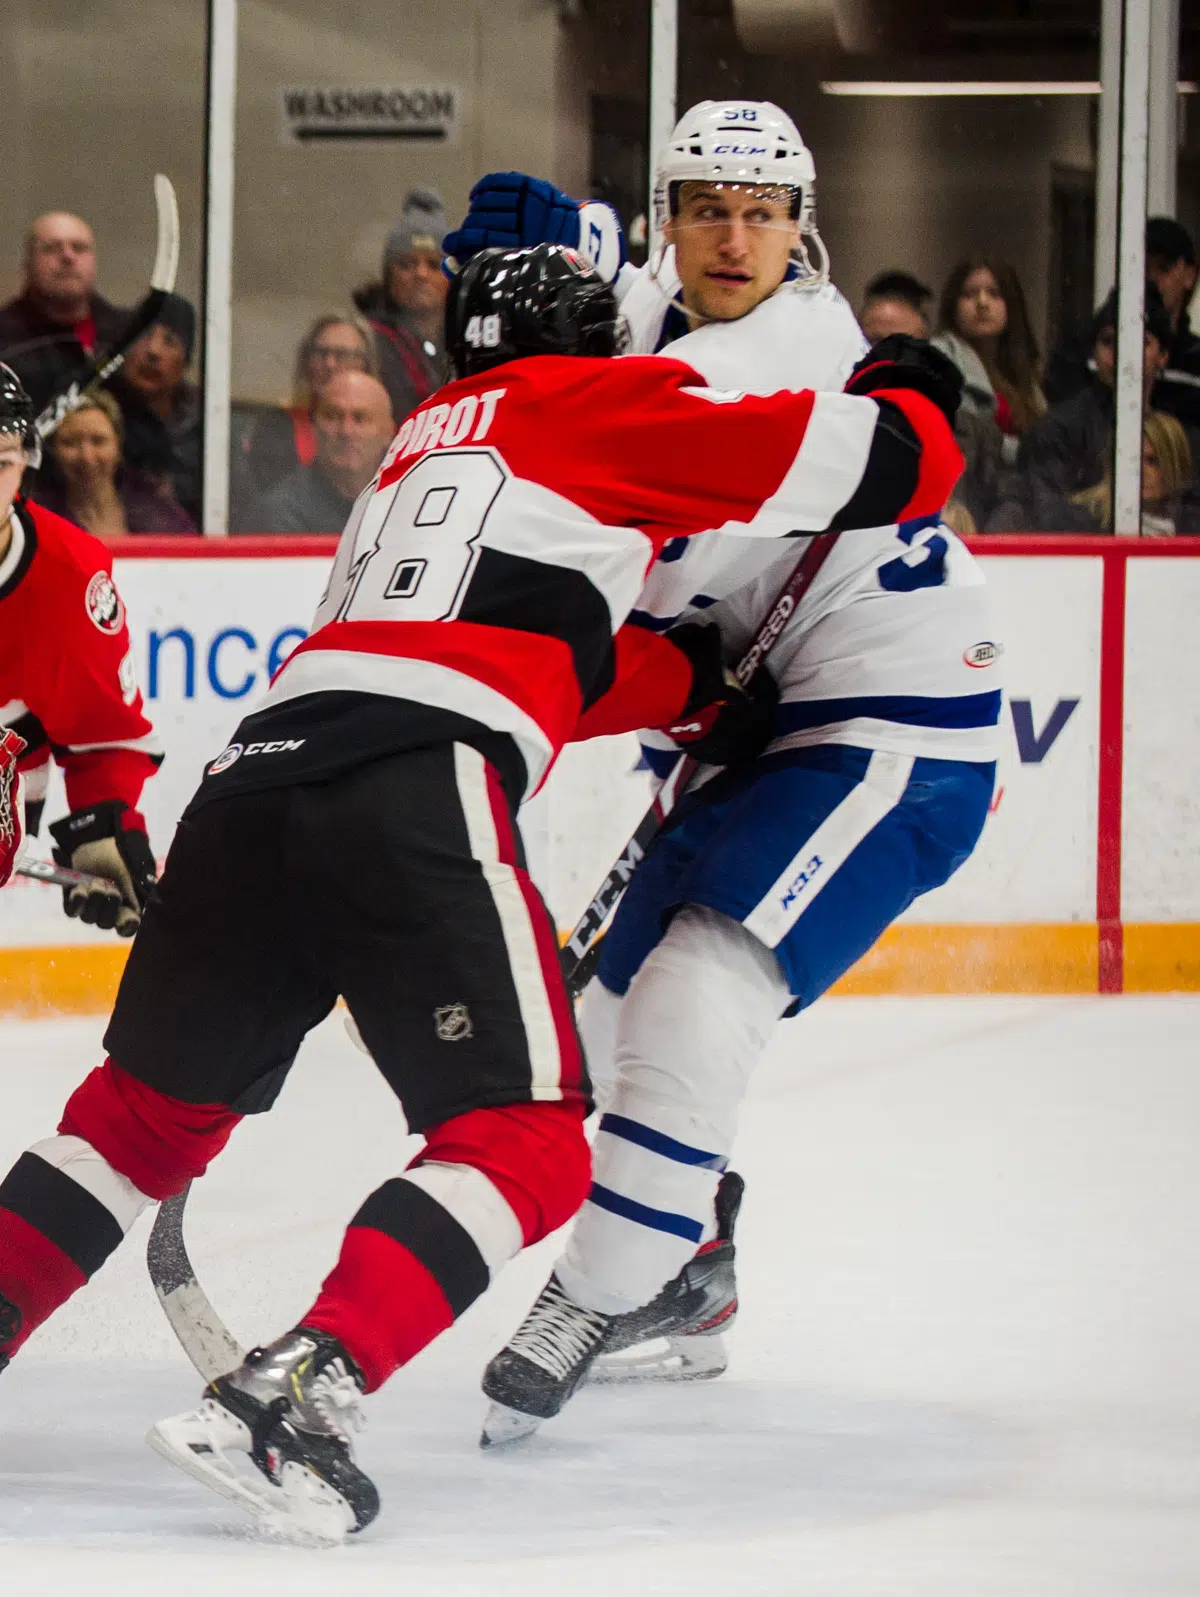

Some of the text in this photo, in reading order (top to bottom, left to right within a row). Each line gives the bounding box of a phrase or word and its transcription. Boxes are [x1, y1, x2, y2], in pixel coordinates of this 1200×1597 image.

[284, 87, 455, 119] WASHROOM
[723, 108, 758, 122] 58
[713, 144, 767, 155] CCM
[464, 312, 501, 349] 48
[734, 594, 794, 688] SPEED
[243, 739, 307, 756] CCM
[565, 838, 645, 960] CCM
[781, 855, 824, 912] CCM
